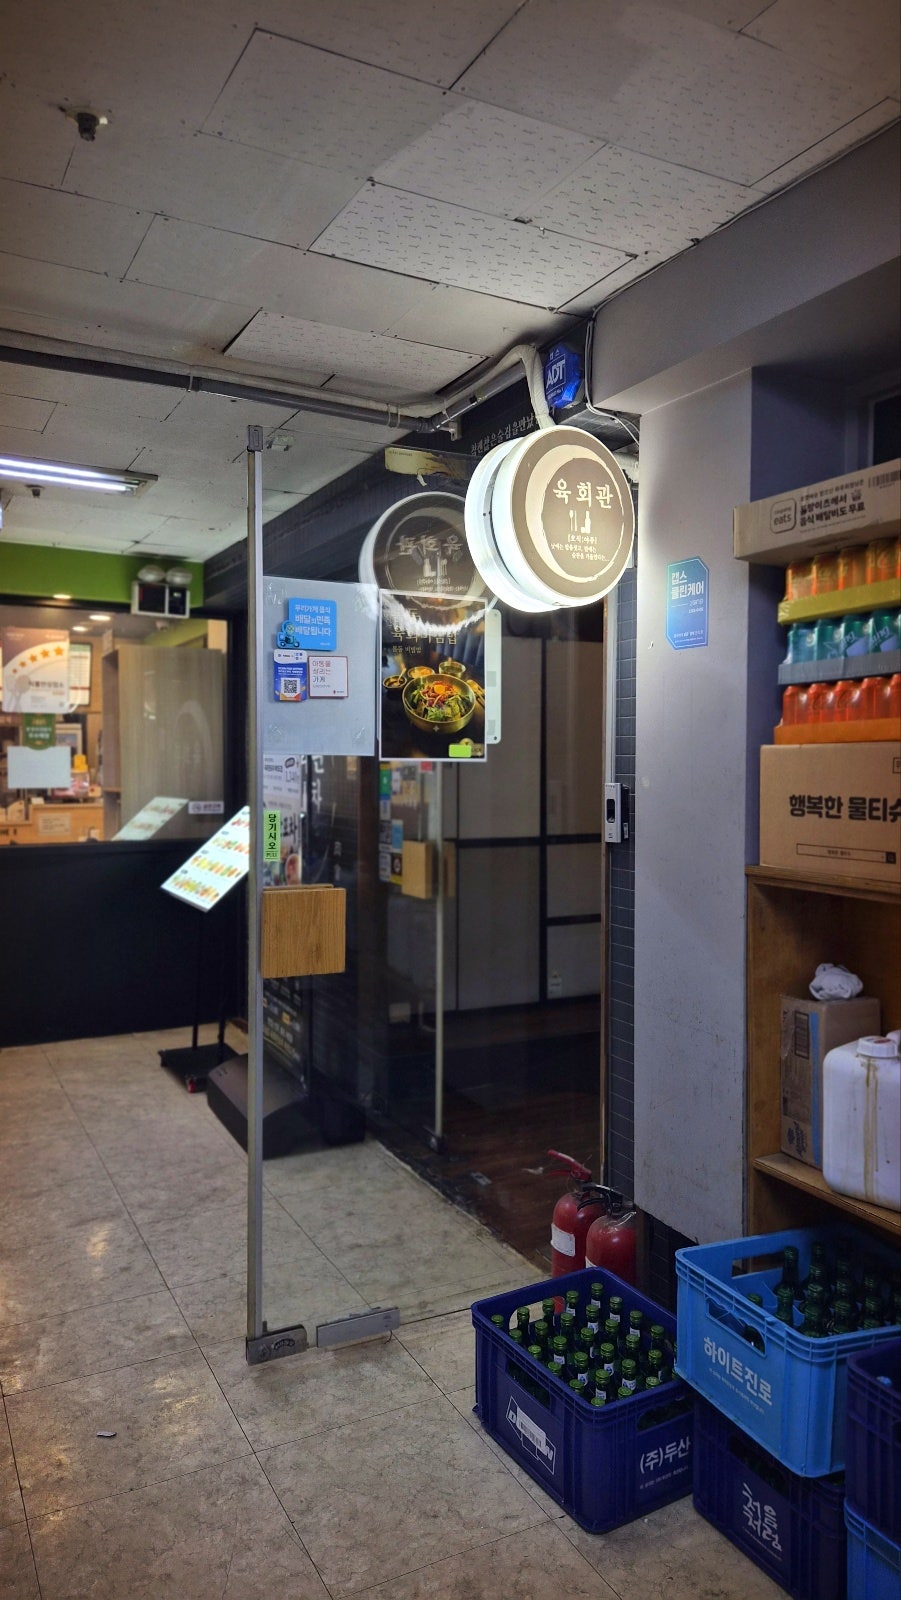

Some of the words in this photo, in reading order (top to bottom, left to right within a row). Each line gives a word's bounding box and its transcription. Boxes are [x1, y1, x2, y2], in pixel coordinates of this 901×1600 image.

[546, 359, 565, 388] ADT
[774, 512, 792, 526] eats
[800, 515, 814, 527] 음식
[816, 507, 847, 522] 배달비도
[848, 501, 866, 514] 무료
[671, 570, 687, 586] 캡스
[671, 580, 704, 600] 클린케어
[295, 604, 319, 613] 우리가게
[789, 794, 843, 819] 행복한
[268, 813, 277, 850] 당기시오
[703, 1336, 774, 1407] 하이트진로
[639, 1435, 691, 1474] (주)두산
